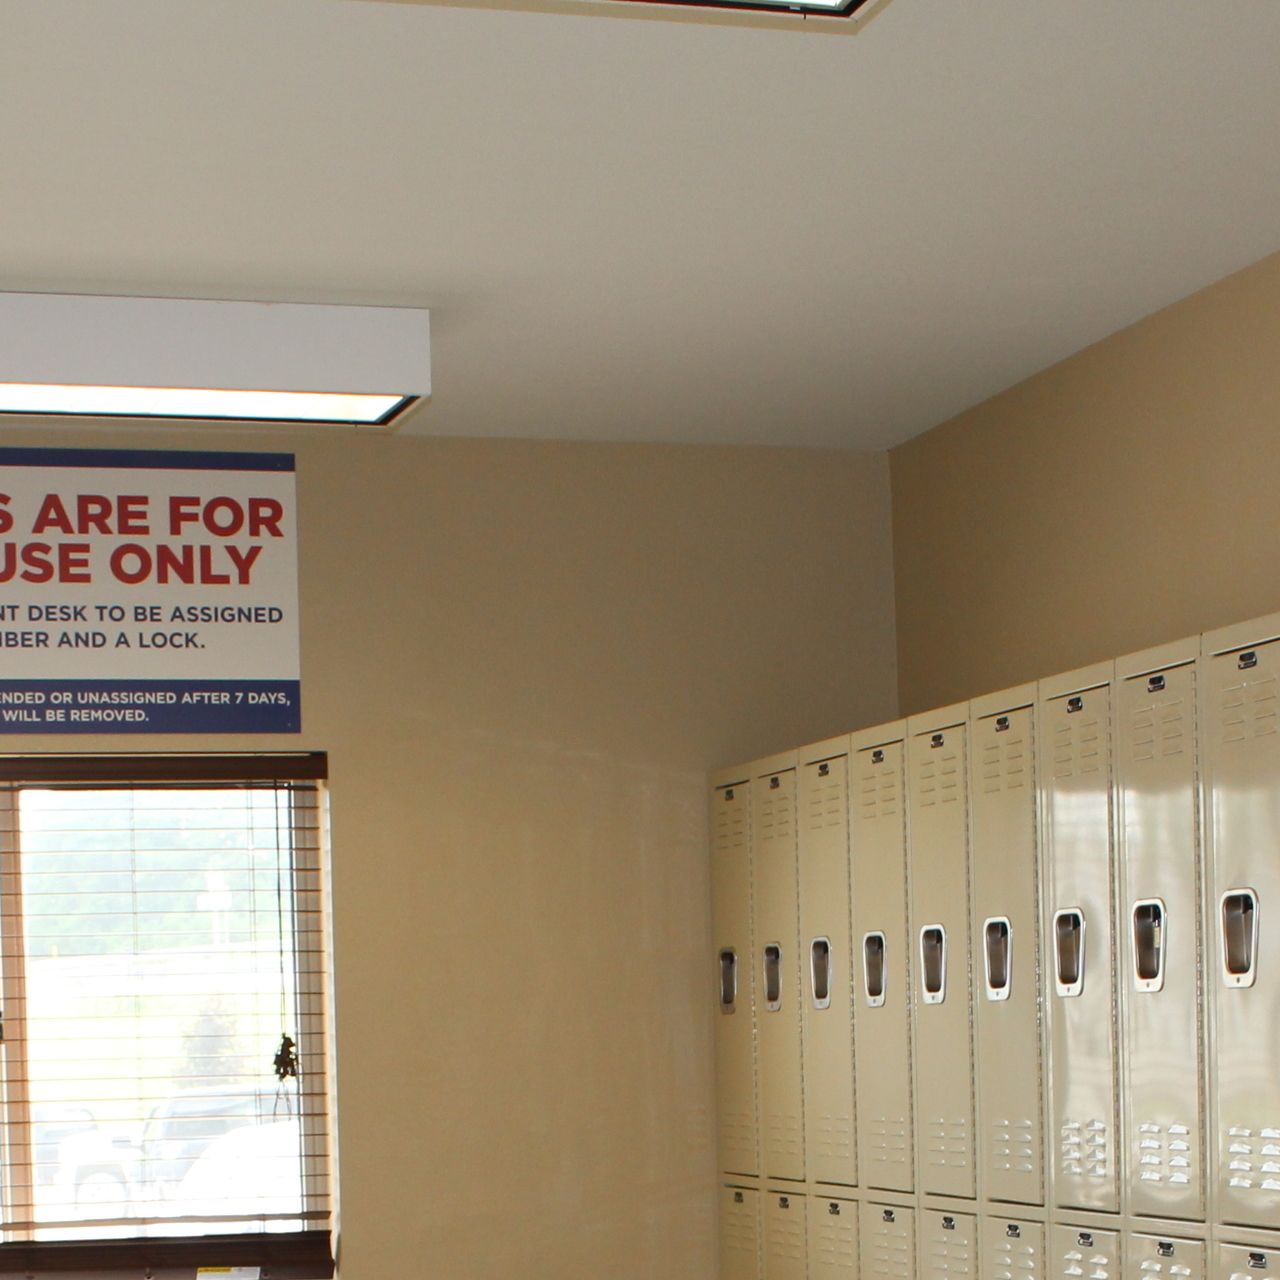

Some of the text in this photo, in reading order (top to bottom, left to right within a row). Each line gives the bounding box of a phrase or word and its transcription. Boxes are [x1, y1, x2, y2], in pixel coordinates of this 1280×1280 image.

[32, 494, 150, 536] ARE
[169, 496, 285, 538] FOR
[111, 544, 263, 585] ONLY
[27, 604, 88, 622] DESK
[94, 605, 126, 623] TO
[133, 605, 163, 623] BE
[169, 605, 284, 624] ASSIGNED
[57, 631, 107, 649] AND
[114, 631, 131, 649] A
[138, 631, 206, 649] LOCK.
[50, 692, 73, 704] OR
[77, 692, 177, 704] UNASSIGNED
[181, 692, 230, 704] AFTER
[235, 692, 244, 704] 7
[248, 692, 291, 706] DAYS,
[2, 709, 42, 722] WILL
[46, 709, 66, 722] BE
[70, 709, 150, 722] REMOVED.
